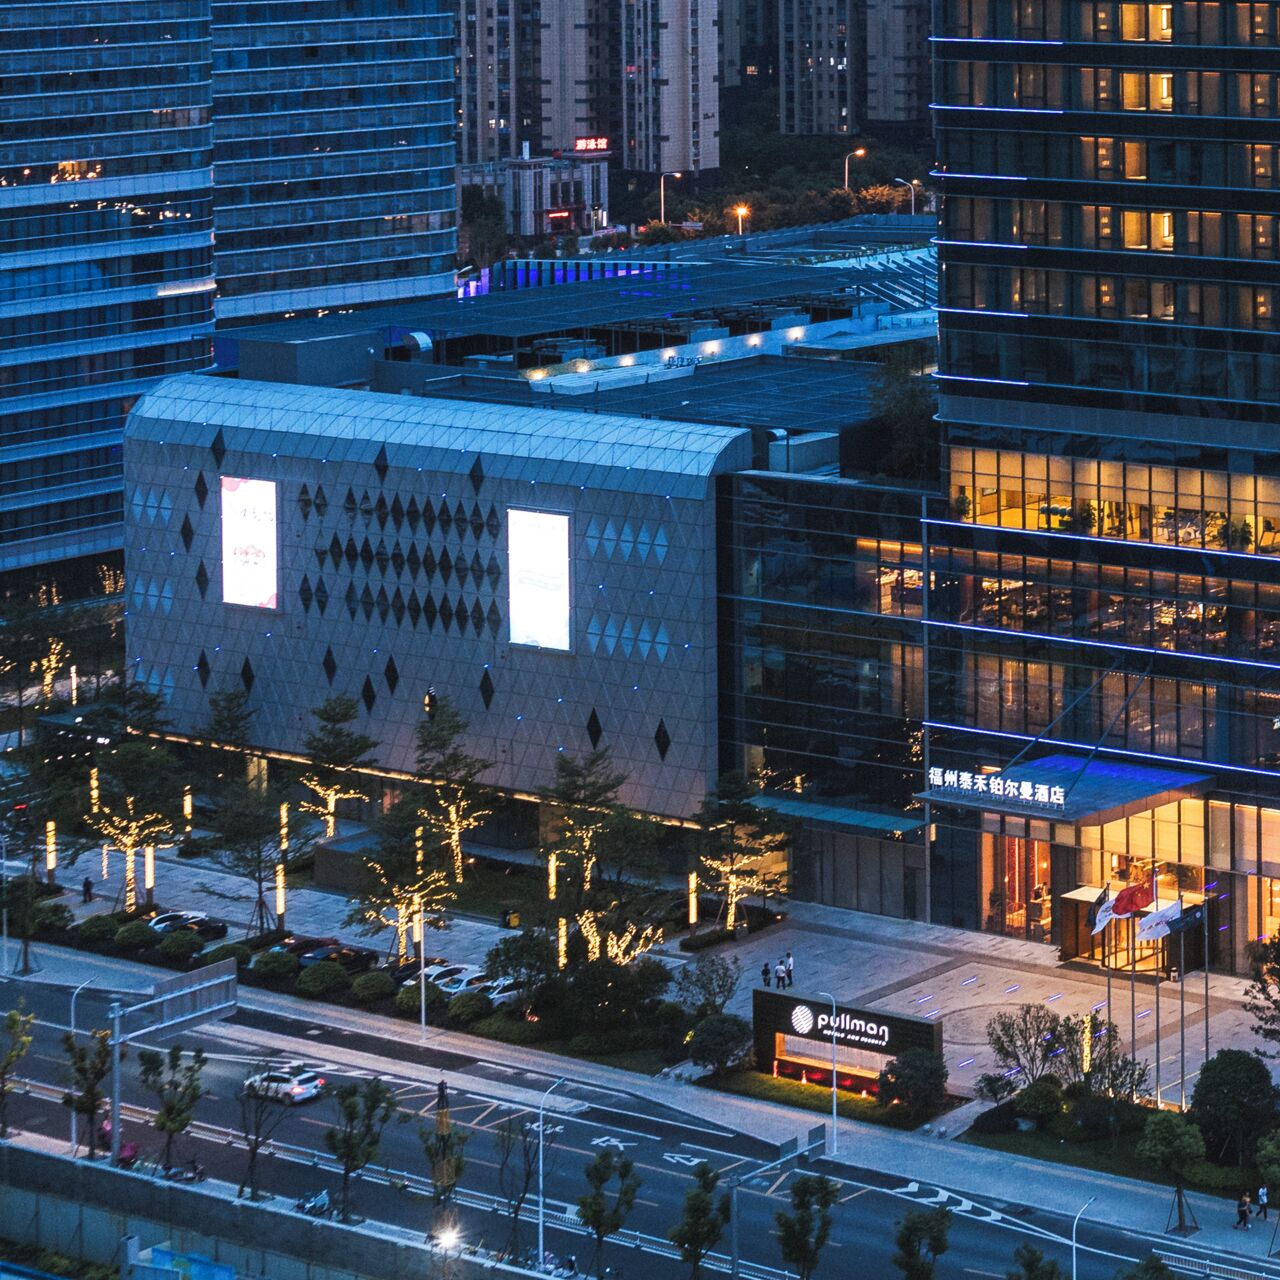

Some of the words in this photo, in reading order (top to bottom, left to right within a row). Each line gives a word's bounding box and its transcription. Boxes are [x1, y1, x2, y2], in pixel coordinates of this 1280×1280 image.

[928, 766, 1065, 804] 福州泰禾铂尔曼酒店
[817, 1013, 889, 1041] pullman
